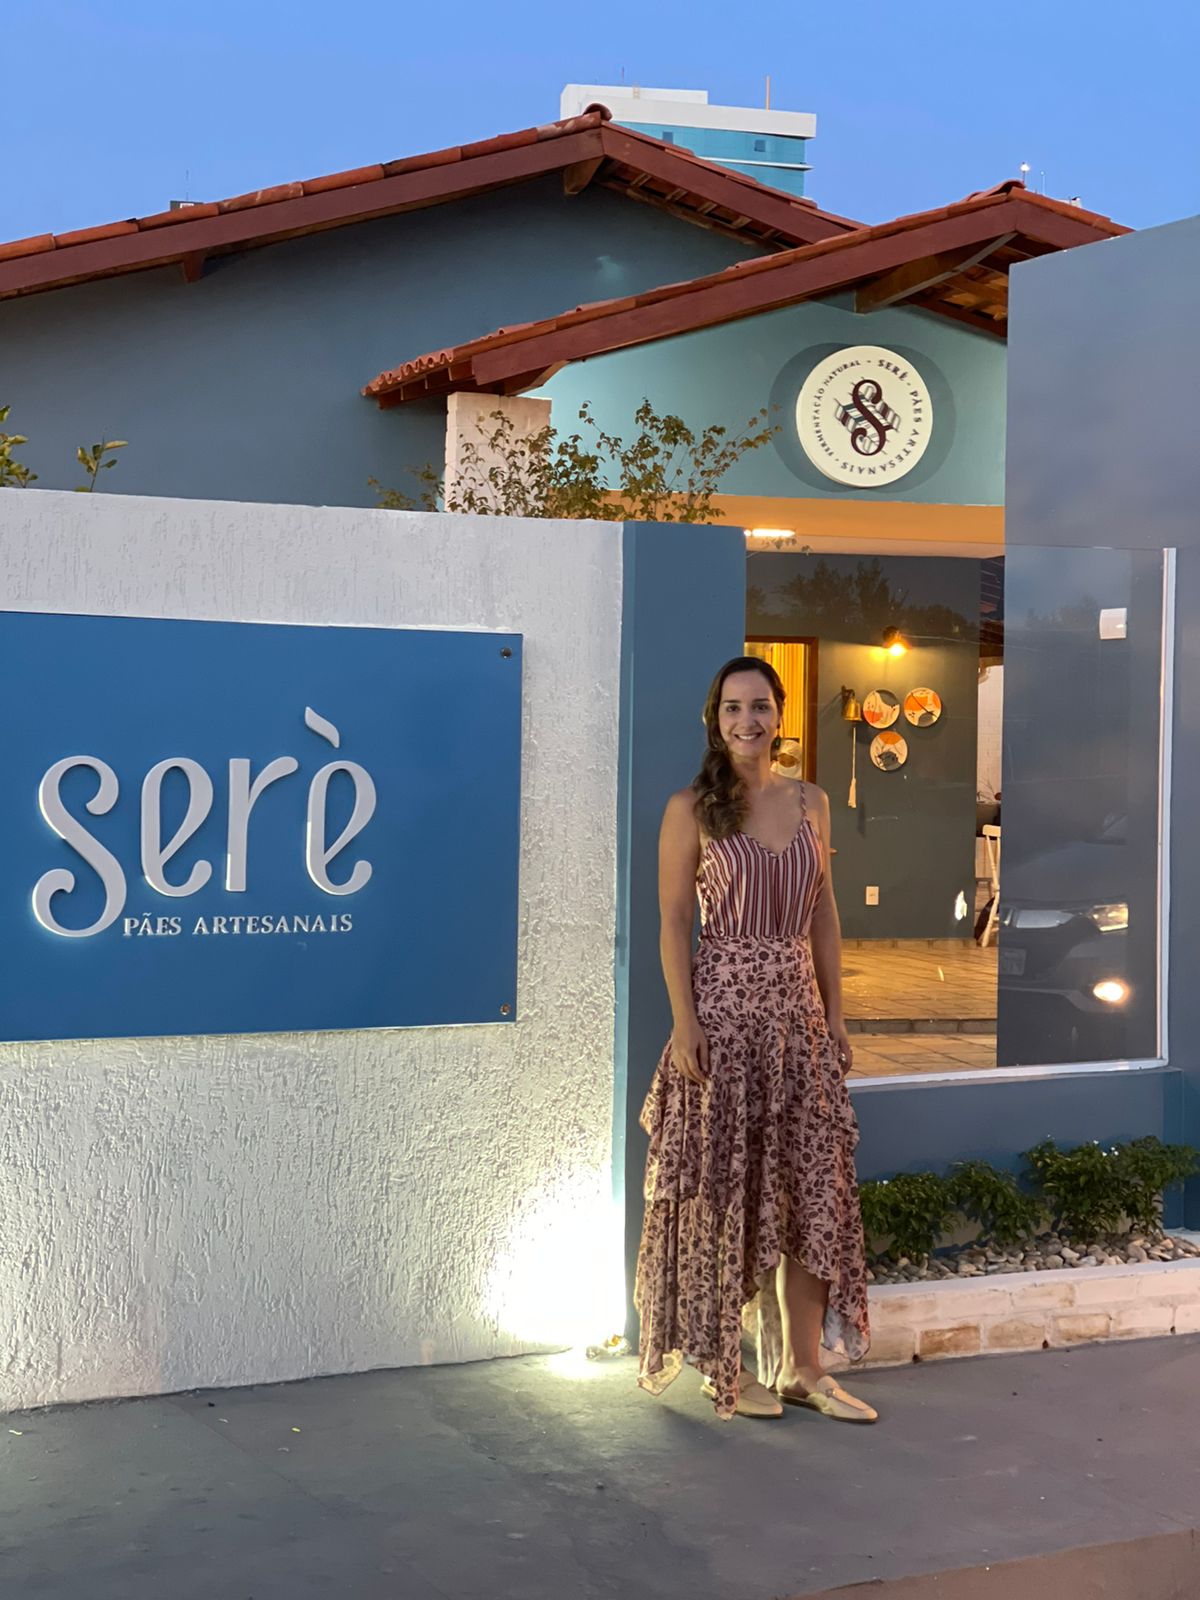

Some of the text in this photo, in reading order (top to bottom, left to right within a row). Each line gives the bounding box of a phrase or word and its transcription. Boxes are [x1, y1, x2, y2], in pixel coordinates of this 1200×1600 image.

[823, 360, 861, 386] NATURAL
[840, 428, 920, 474] ARTESANAIS
[122, 912, 353, 937] PÃES ARTESANAIS
